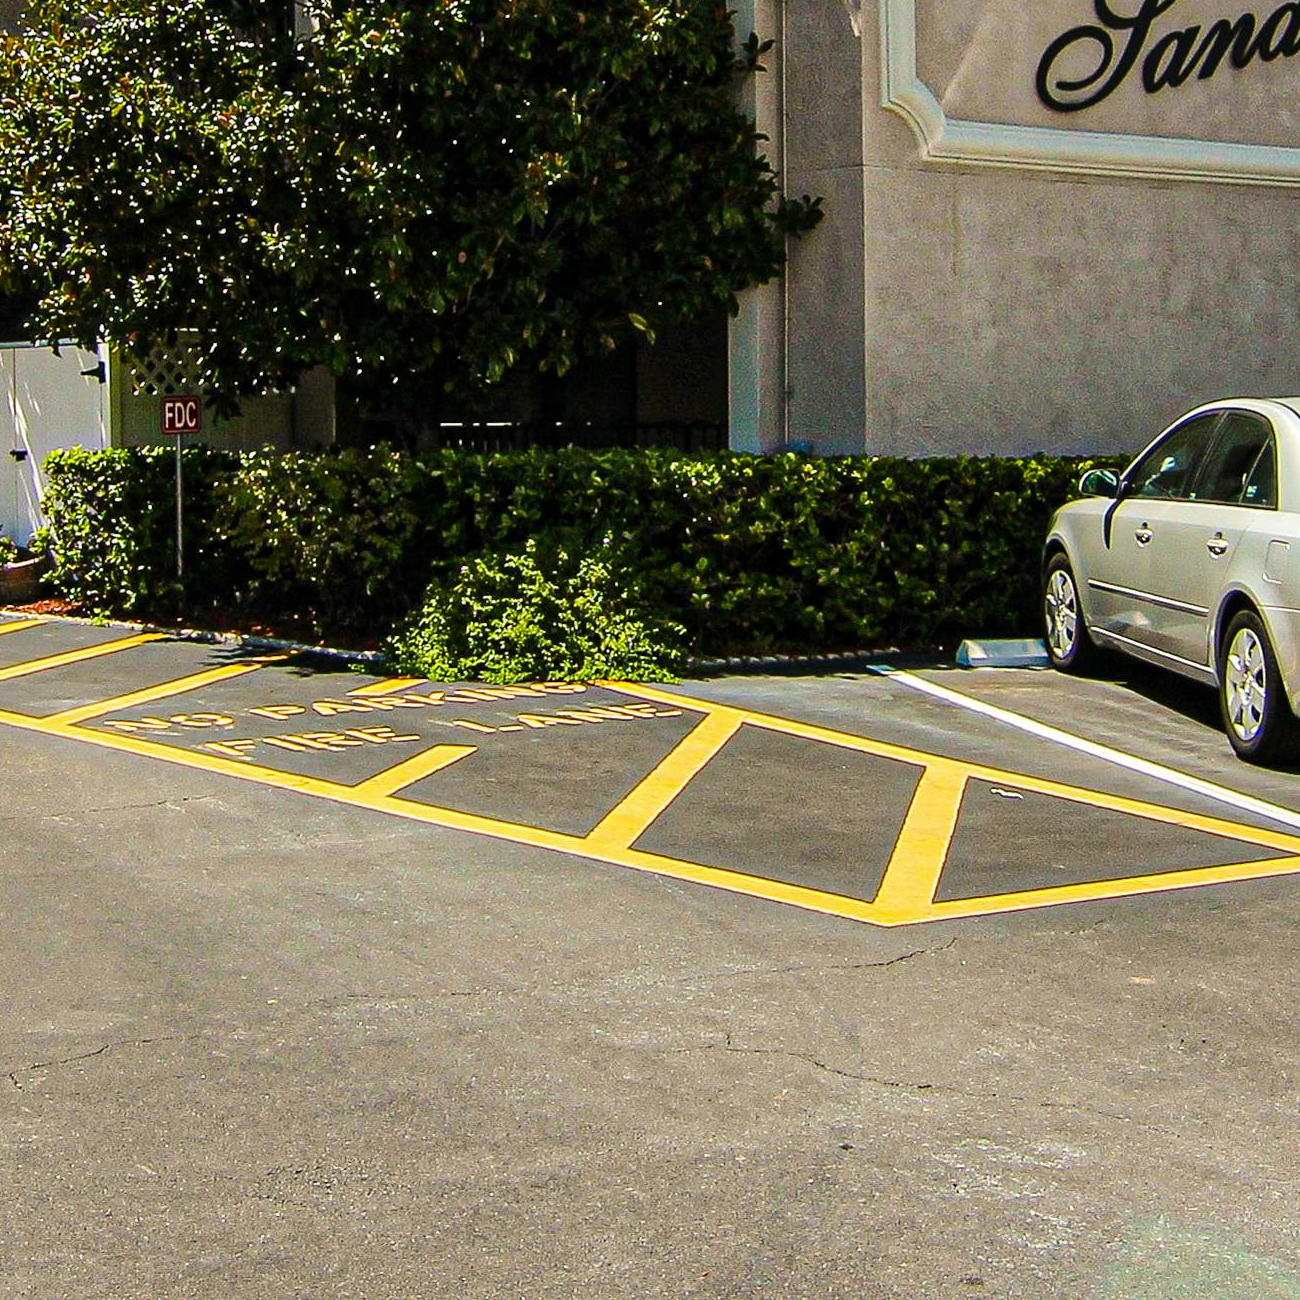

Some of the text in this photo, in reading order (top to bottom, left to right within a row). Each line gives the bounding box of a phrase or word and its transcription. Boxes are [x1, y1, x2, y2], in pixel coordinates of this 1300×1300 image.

[164, 401, 197, 429] FDC
[103, 681, 587, 732] NO PARKING
[204, 703, 685, 756] FIRE LANE
